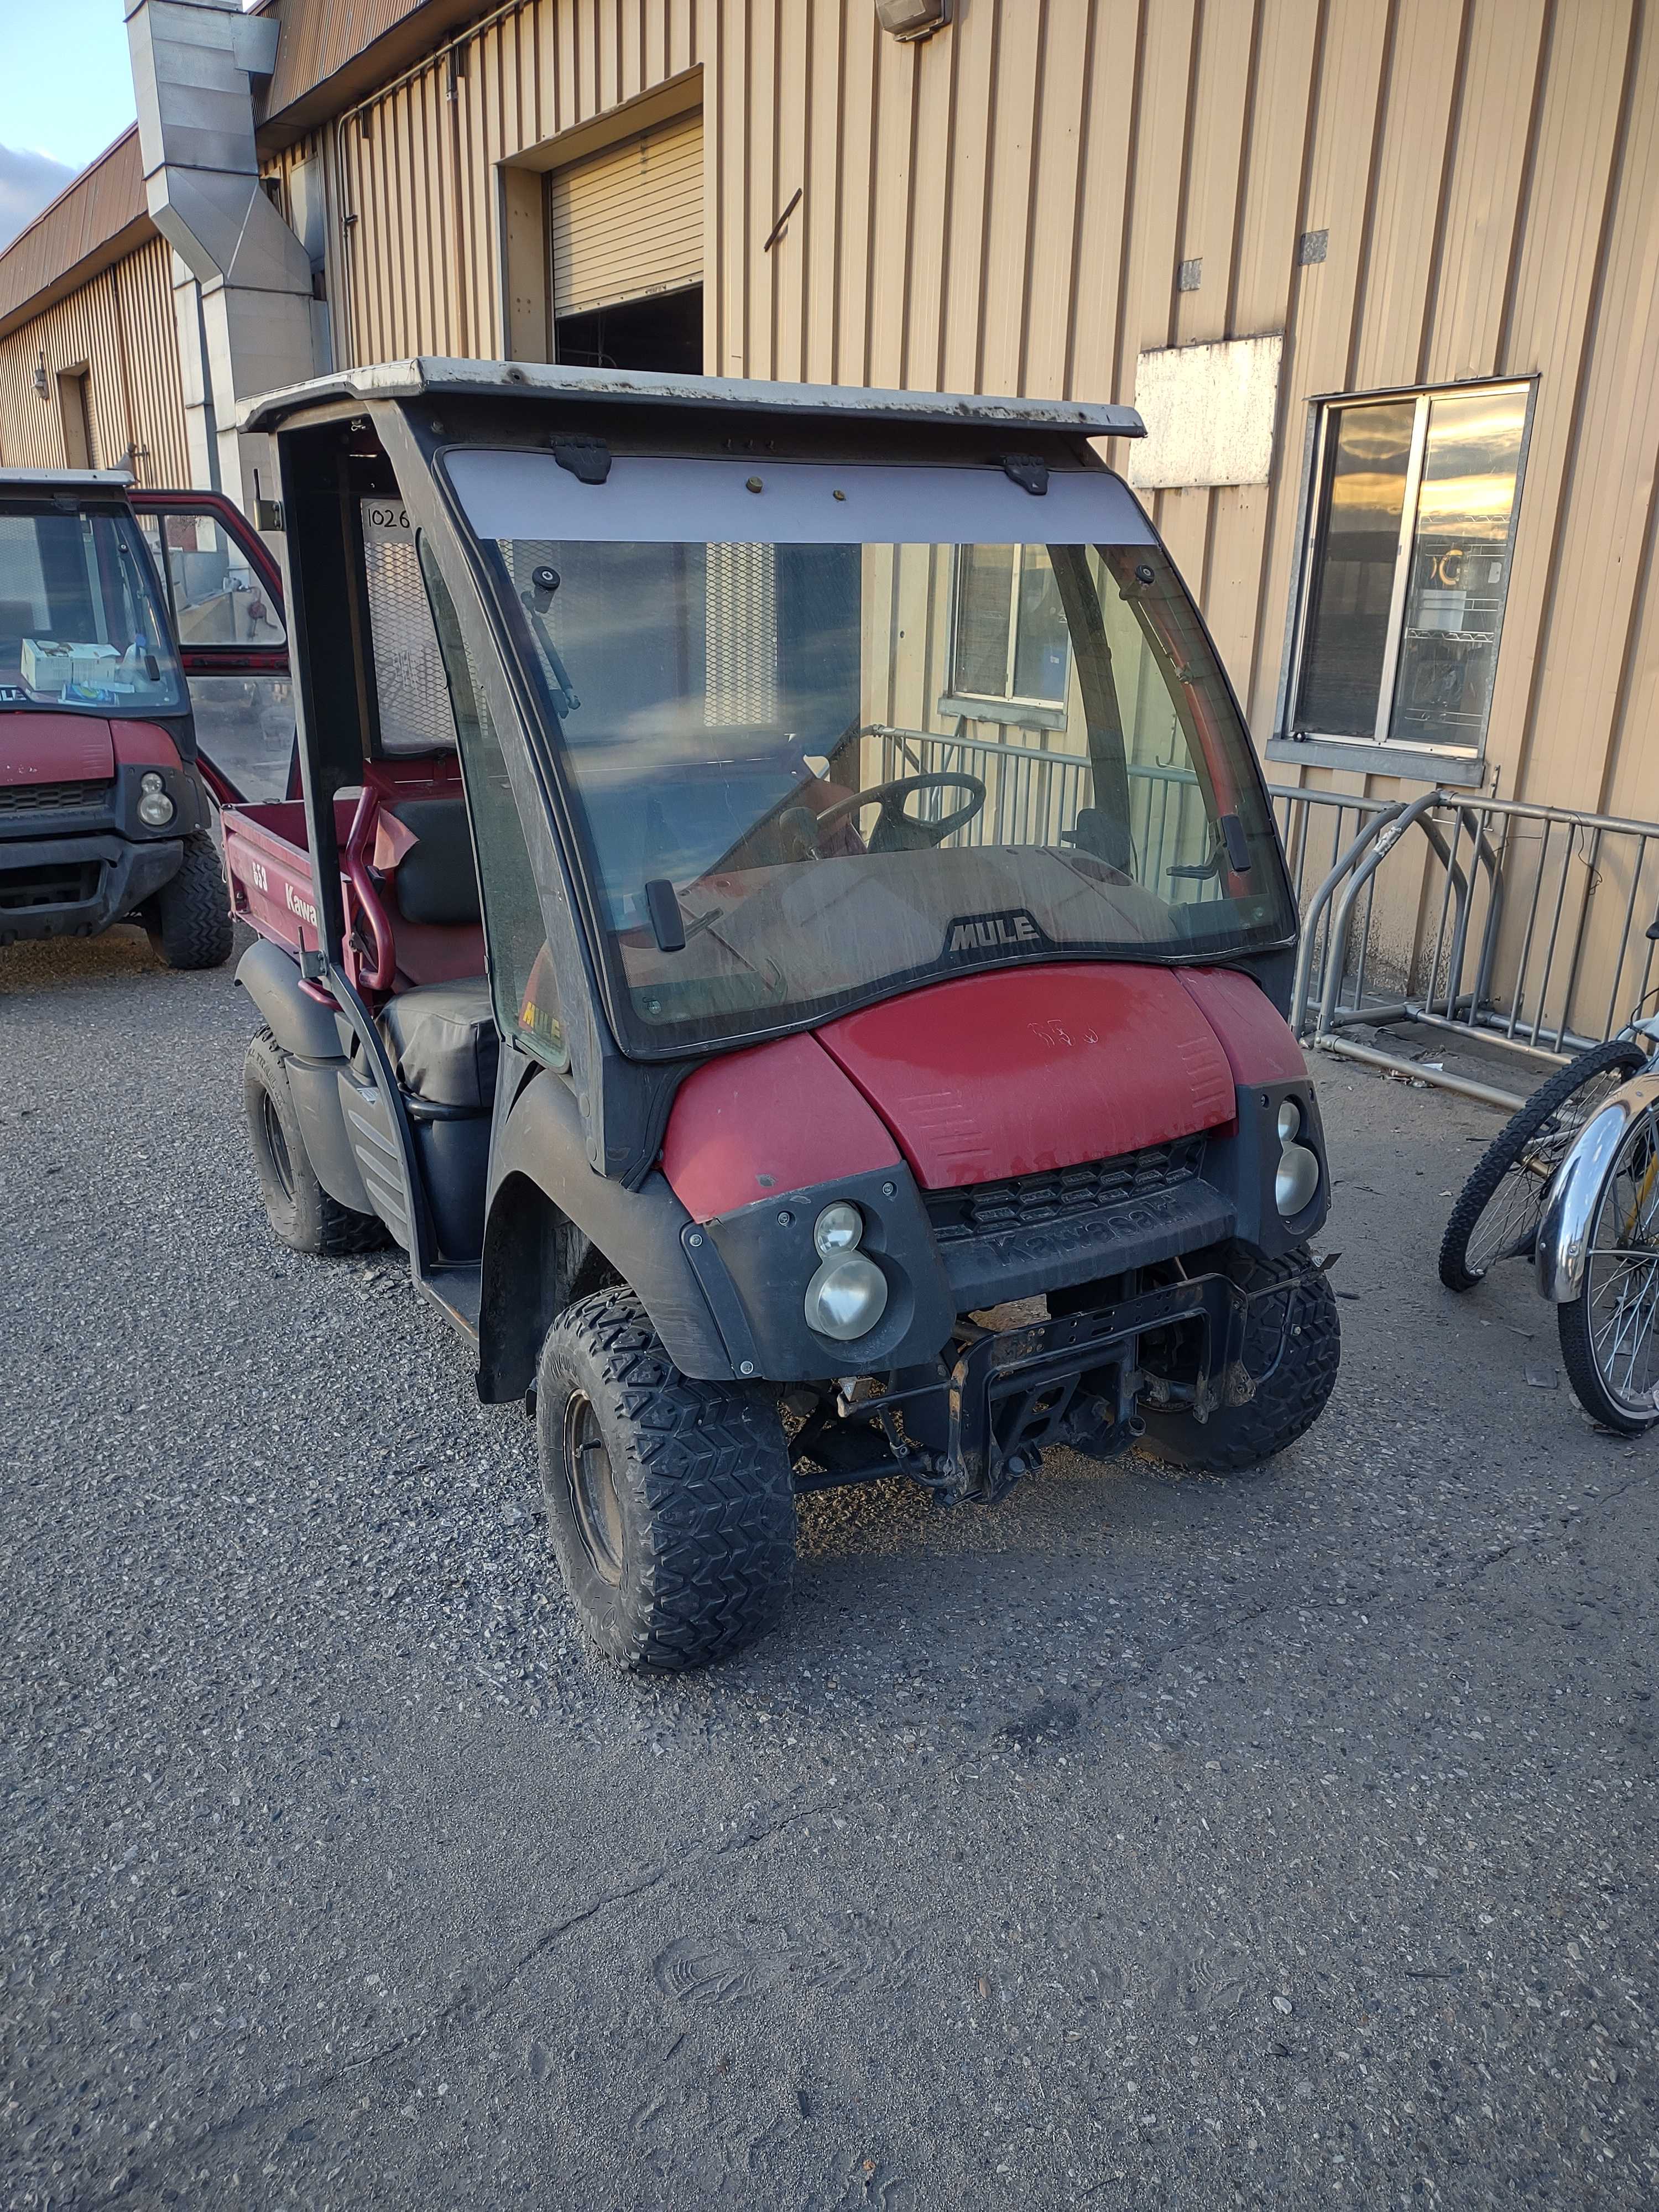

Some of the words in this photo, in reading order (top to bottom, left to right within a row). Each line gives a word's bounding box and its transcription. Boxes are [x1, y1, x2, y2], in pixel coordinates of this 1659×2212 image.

[368, 508, 410, 528] 1026
[950, 916, 1040, 952] MULE
[523, 1001, 561, 1044] MULE
